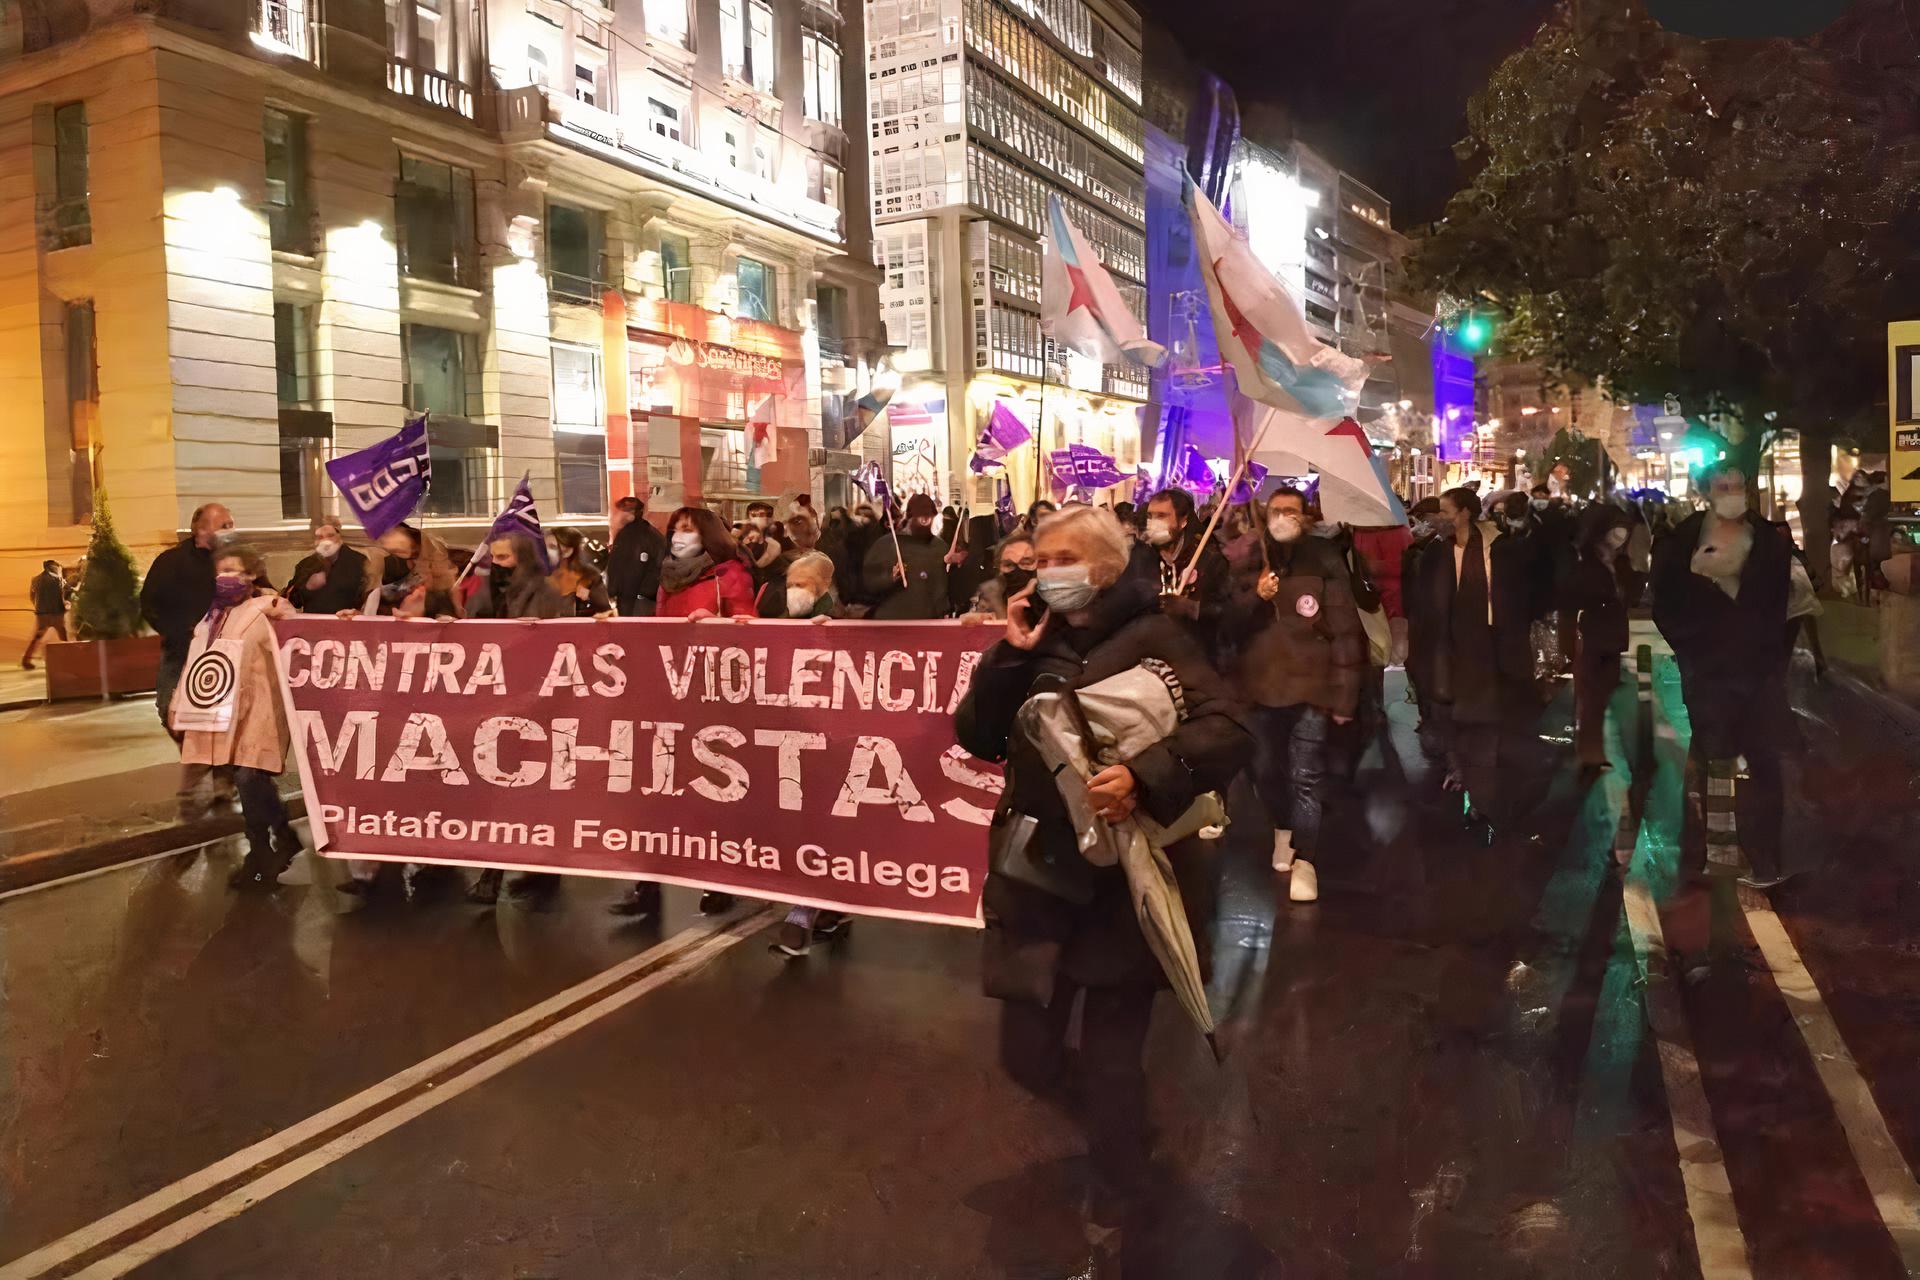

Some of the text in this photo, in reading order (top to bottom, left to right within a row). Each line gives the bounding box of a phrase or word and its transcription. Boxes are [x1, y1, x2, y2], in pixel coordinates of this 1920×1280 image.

[284, 637, 507, 695] CONTRA
[539, 642, 628, 697] AS
[296, 710, 1006, 826] MACHISTAS
[320, 804, 970, 898] Plataforma Feminista Galega
